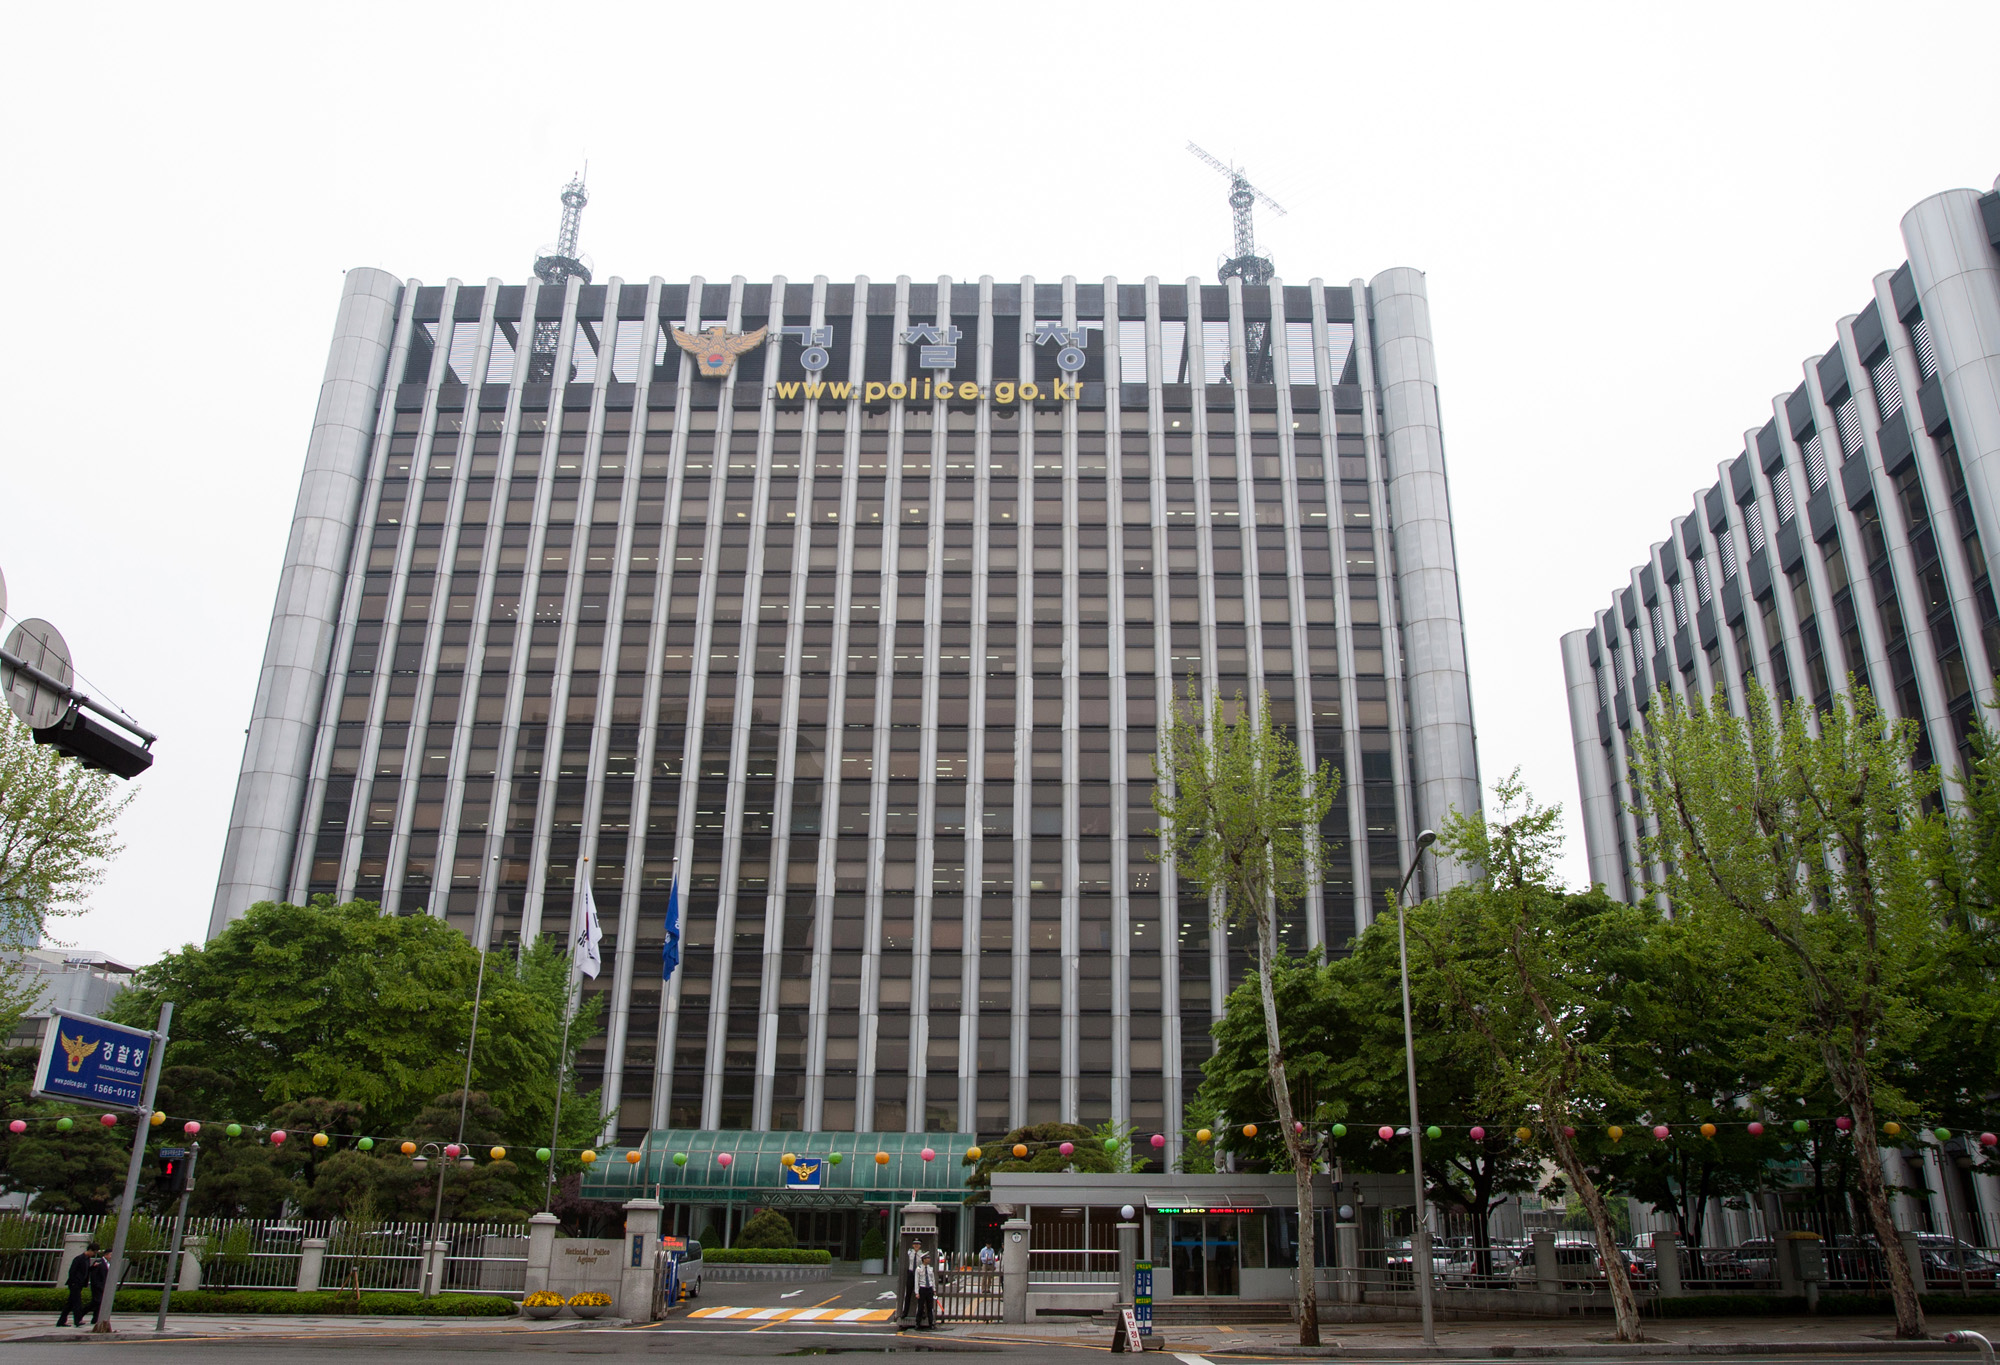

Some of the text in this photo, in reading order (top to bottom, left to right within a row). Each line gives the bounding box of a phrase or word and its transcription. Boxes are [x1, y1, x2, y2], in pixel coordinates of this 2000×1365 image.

[781, 322, 1089, 373] 경찰청
[775, 377, 1084, 404] www.police.go.kr
[103, 1042, 144, 1067] 경찰청
[115, 1067, 126, 1075] POLICE
[94, 1084, 136, 1098] 1566-0112
[565, 1248, 610, 1256] National Police
[577, 1256, 597, 1265] Agency
[1126, 1312, 1140, 1347] 일단정지
